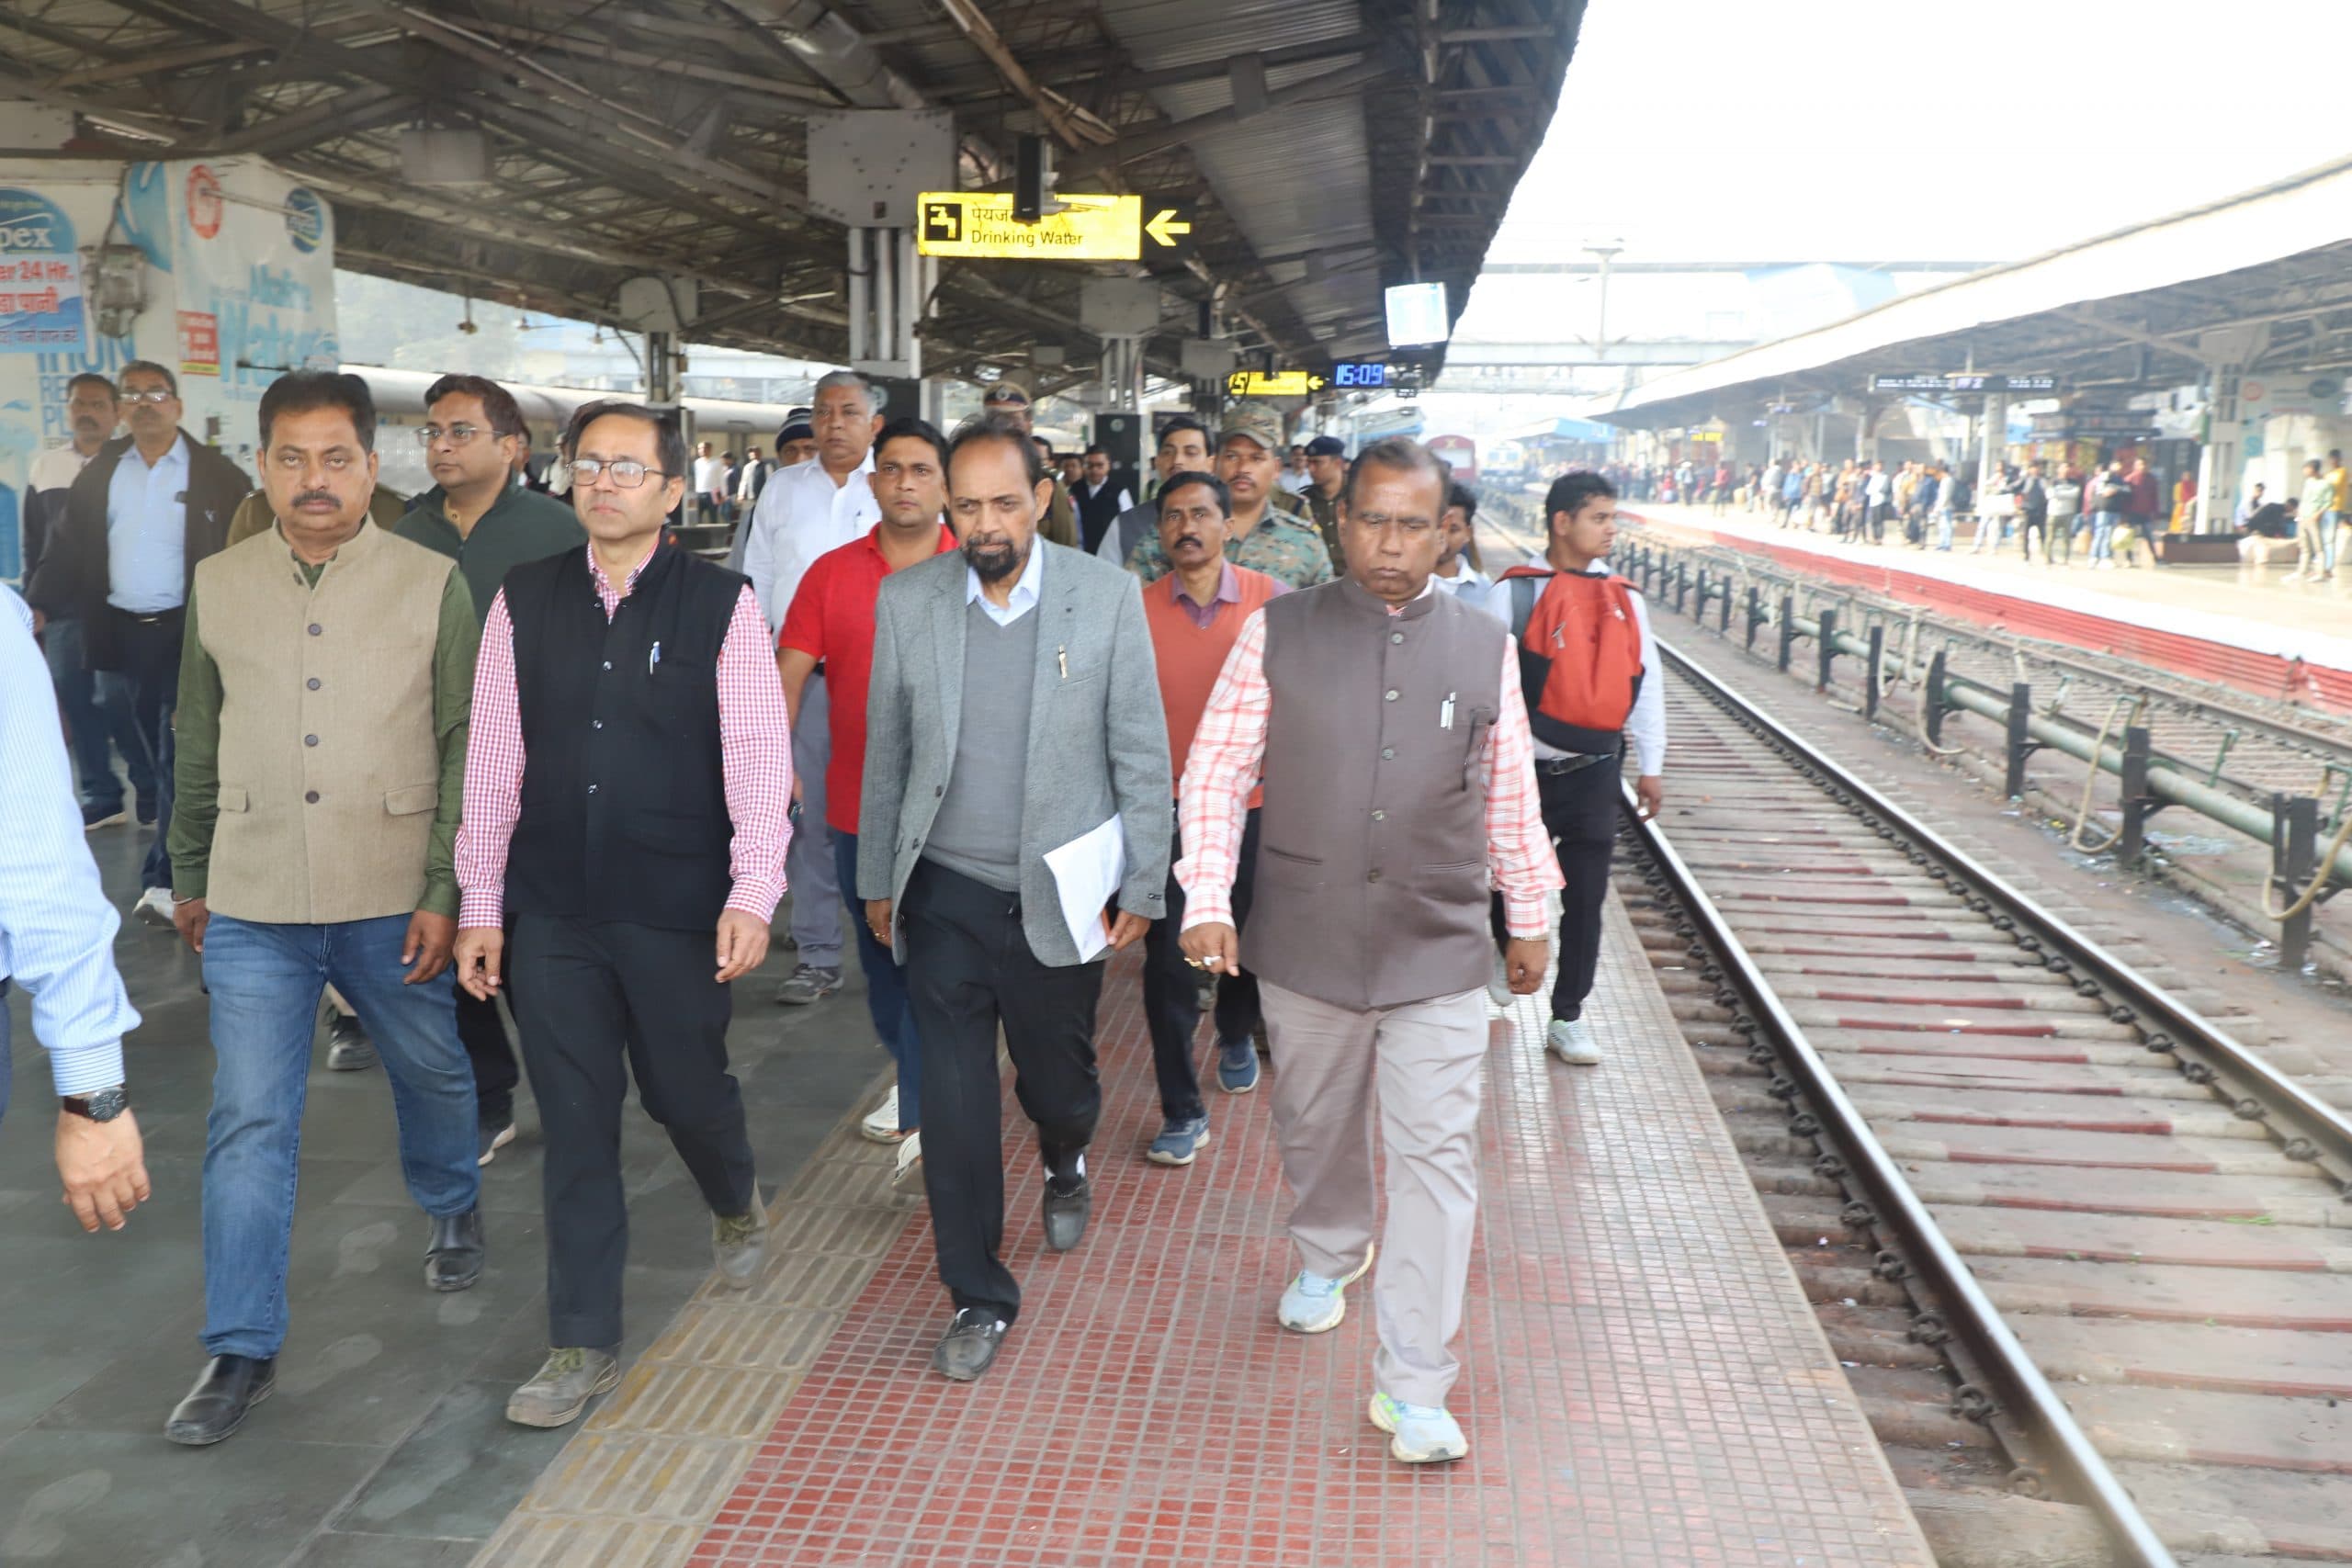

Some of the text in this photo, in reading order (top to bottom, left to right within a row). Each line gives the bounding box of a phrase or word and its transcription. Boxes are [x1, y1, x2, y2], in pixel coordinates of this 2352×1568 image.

[972, 230, 1083, 248] Drinking Water
[18, 261, 43, 280] 24
[1336, 364, 1384, 386] 15:09
